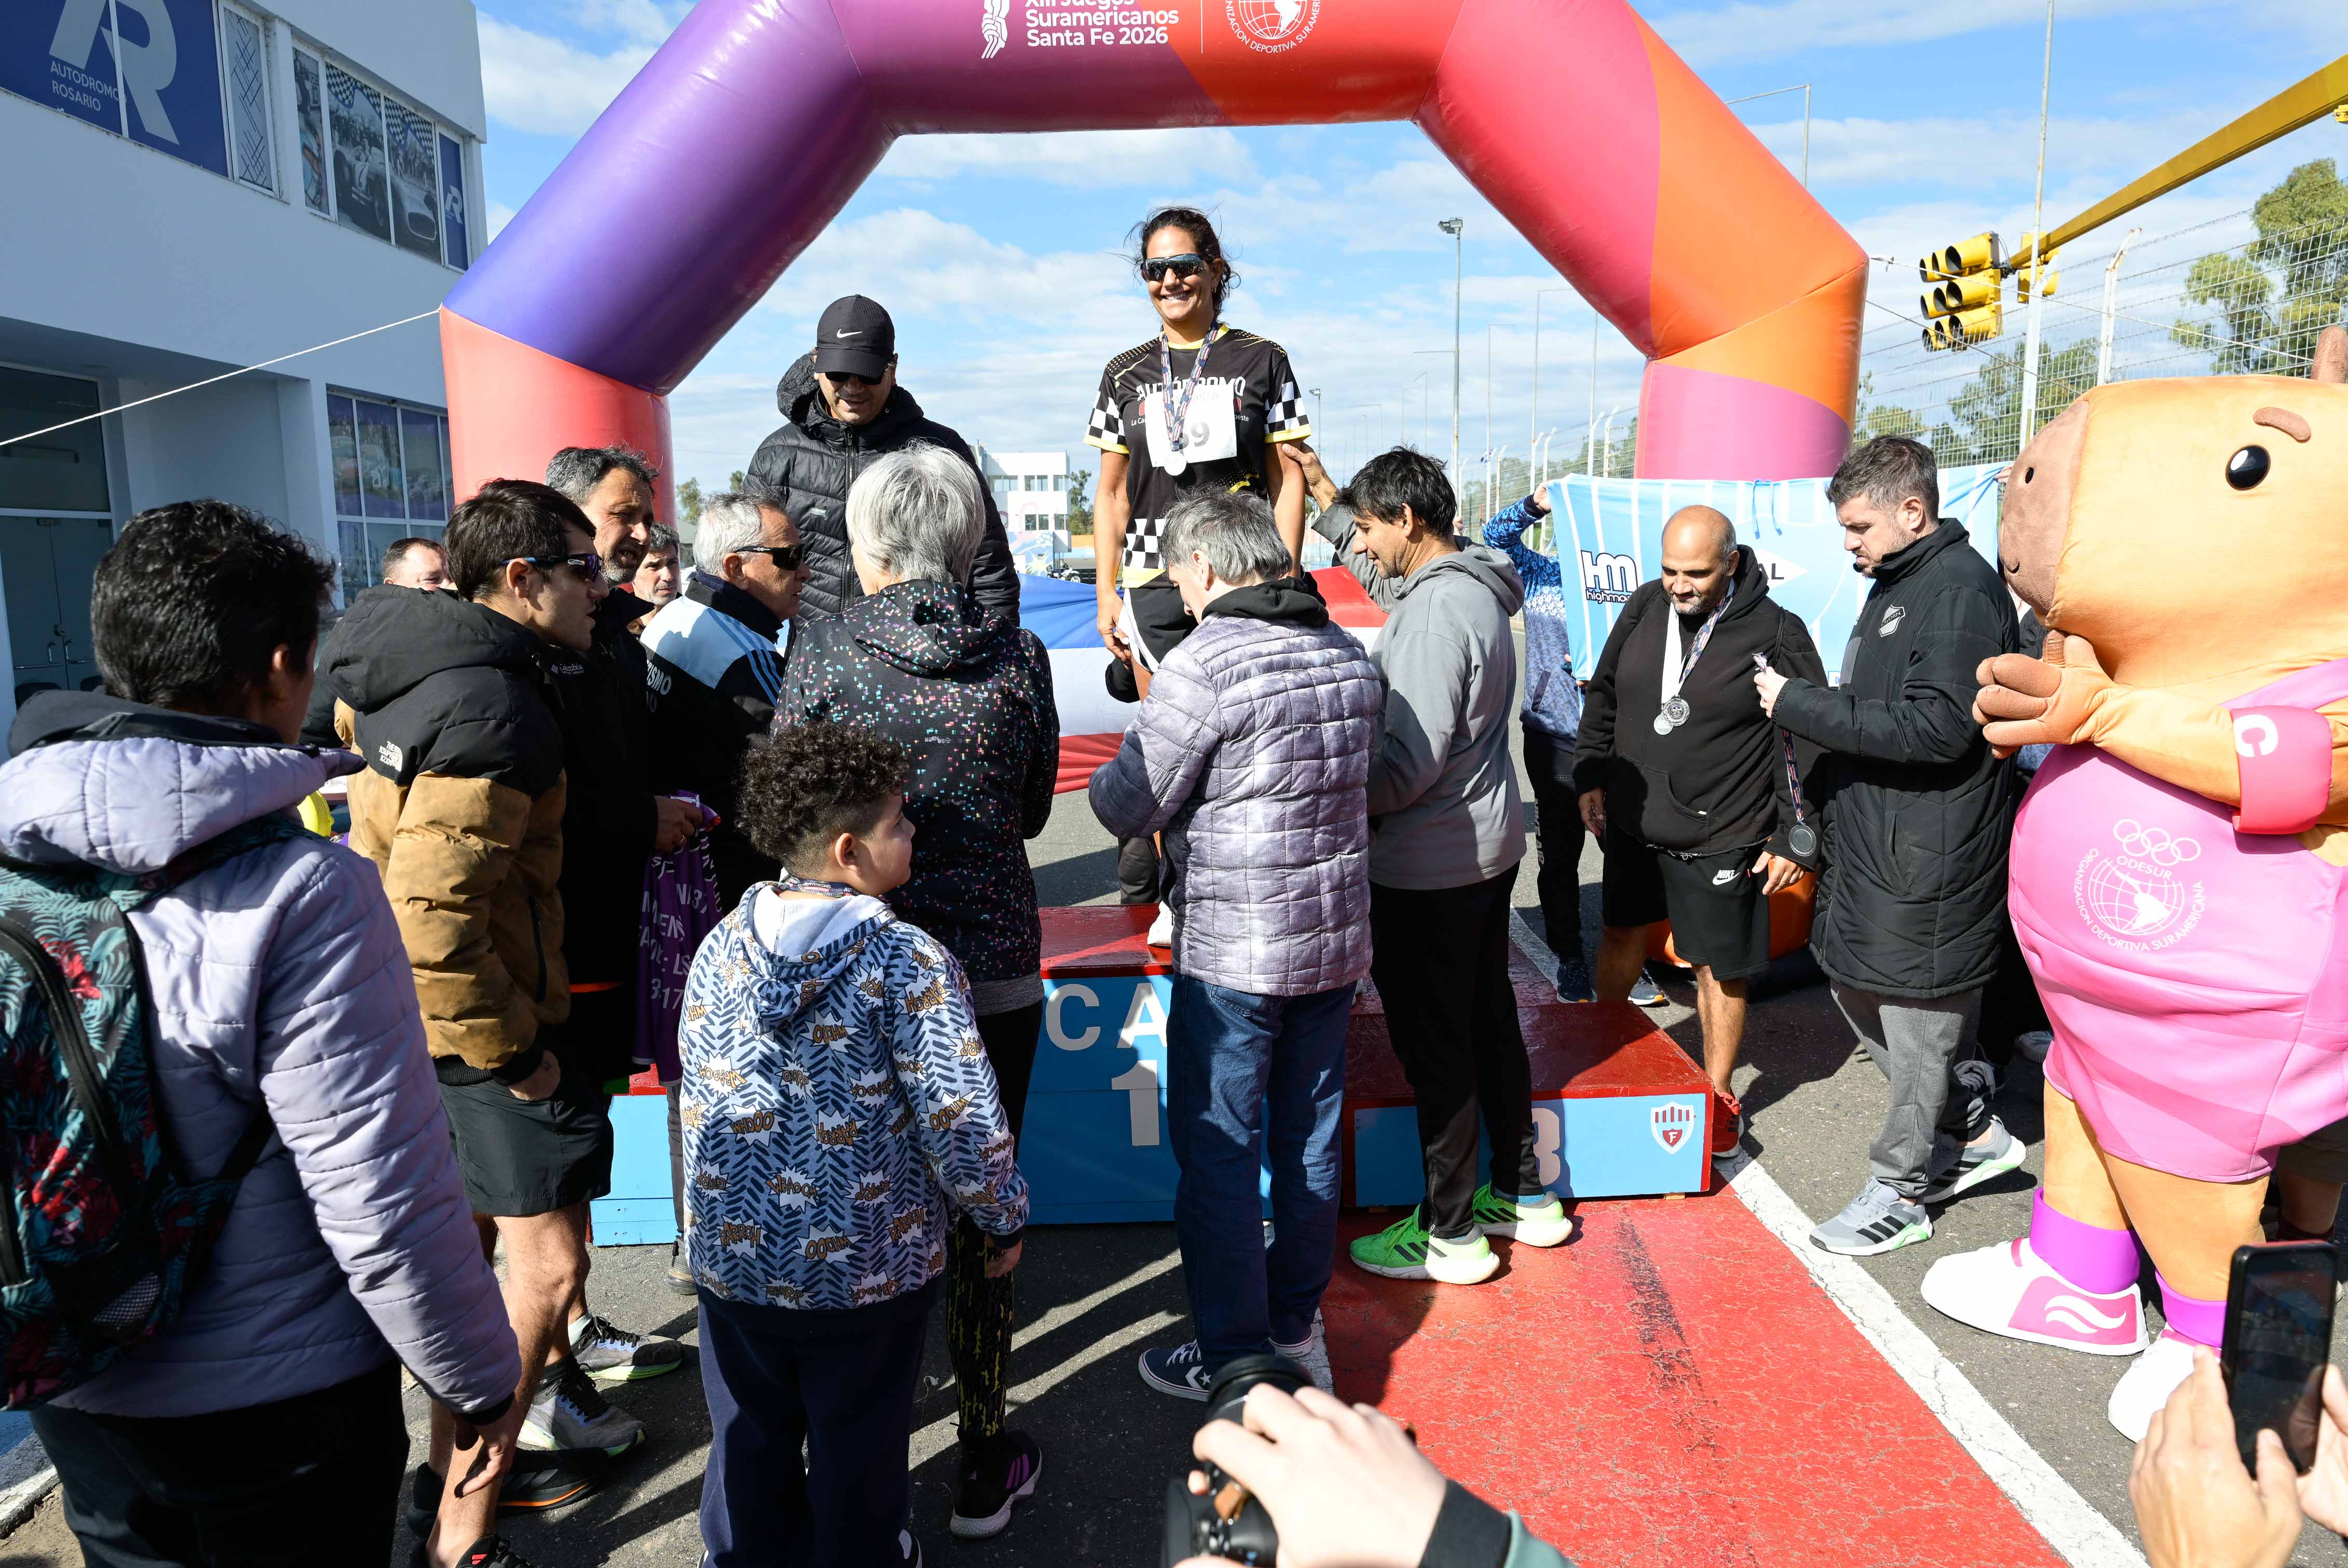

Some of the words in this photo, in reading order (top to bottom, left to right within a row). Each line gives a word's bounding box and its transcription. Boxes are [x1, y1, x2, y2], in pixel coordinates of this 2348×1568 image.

[1026, 6, 1179, 27] Suramericanos
[1225, 0, 1250, 45] NIZACION
[1249, 40, 1297, 54] DEPORTIVA
[1027, 29, 1085, 47] Santa
[1090, 28, 1115, 45] Fe
[1119, 26, 1169, 45] 2026
[52, 80, 101, 111] ROSARIO
[1716, 869, 1736, 879] NIKE
[2117, 856, 2173, 880] ODESUR
[2074, 848, 2099, 925] ORGANIZACION
[2091, 925, 2149, 951] DEPORTIVA
[2151, 880, 2205, 950] SURAMERICANA
[1111, 1059, 1160, 1146] 1
